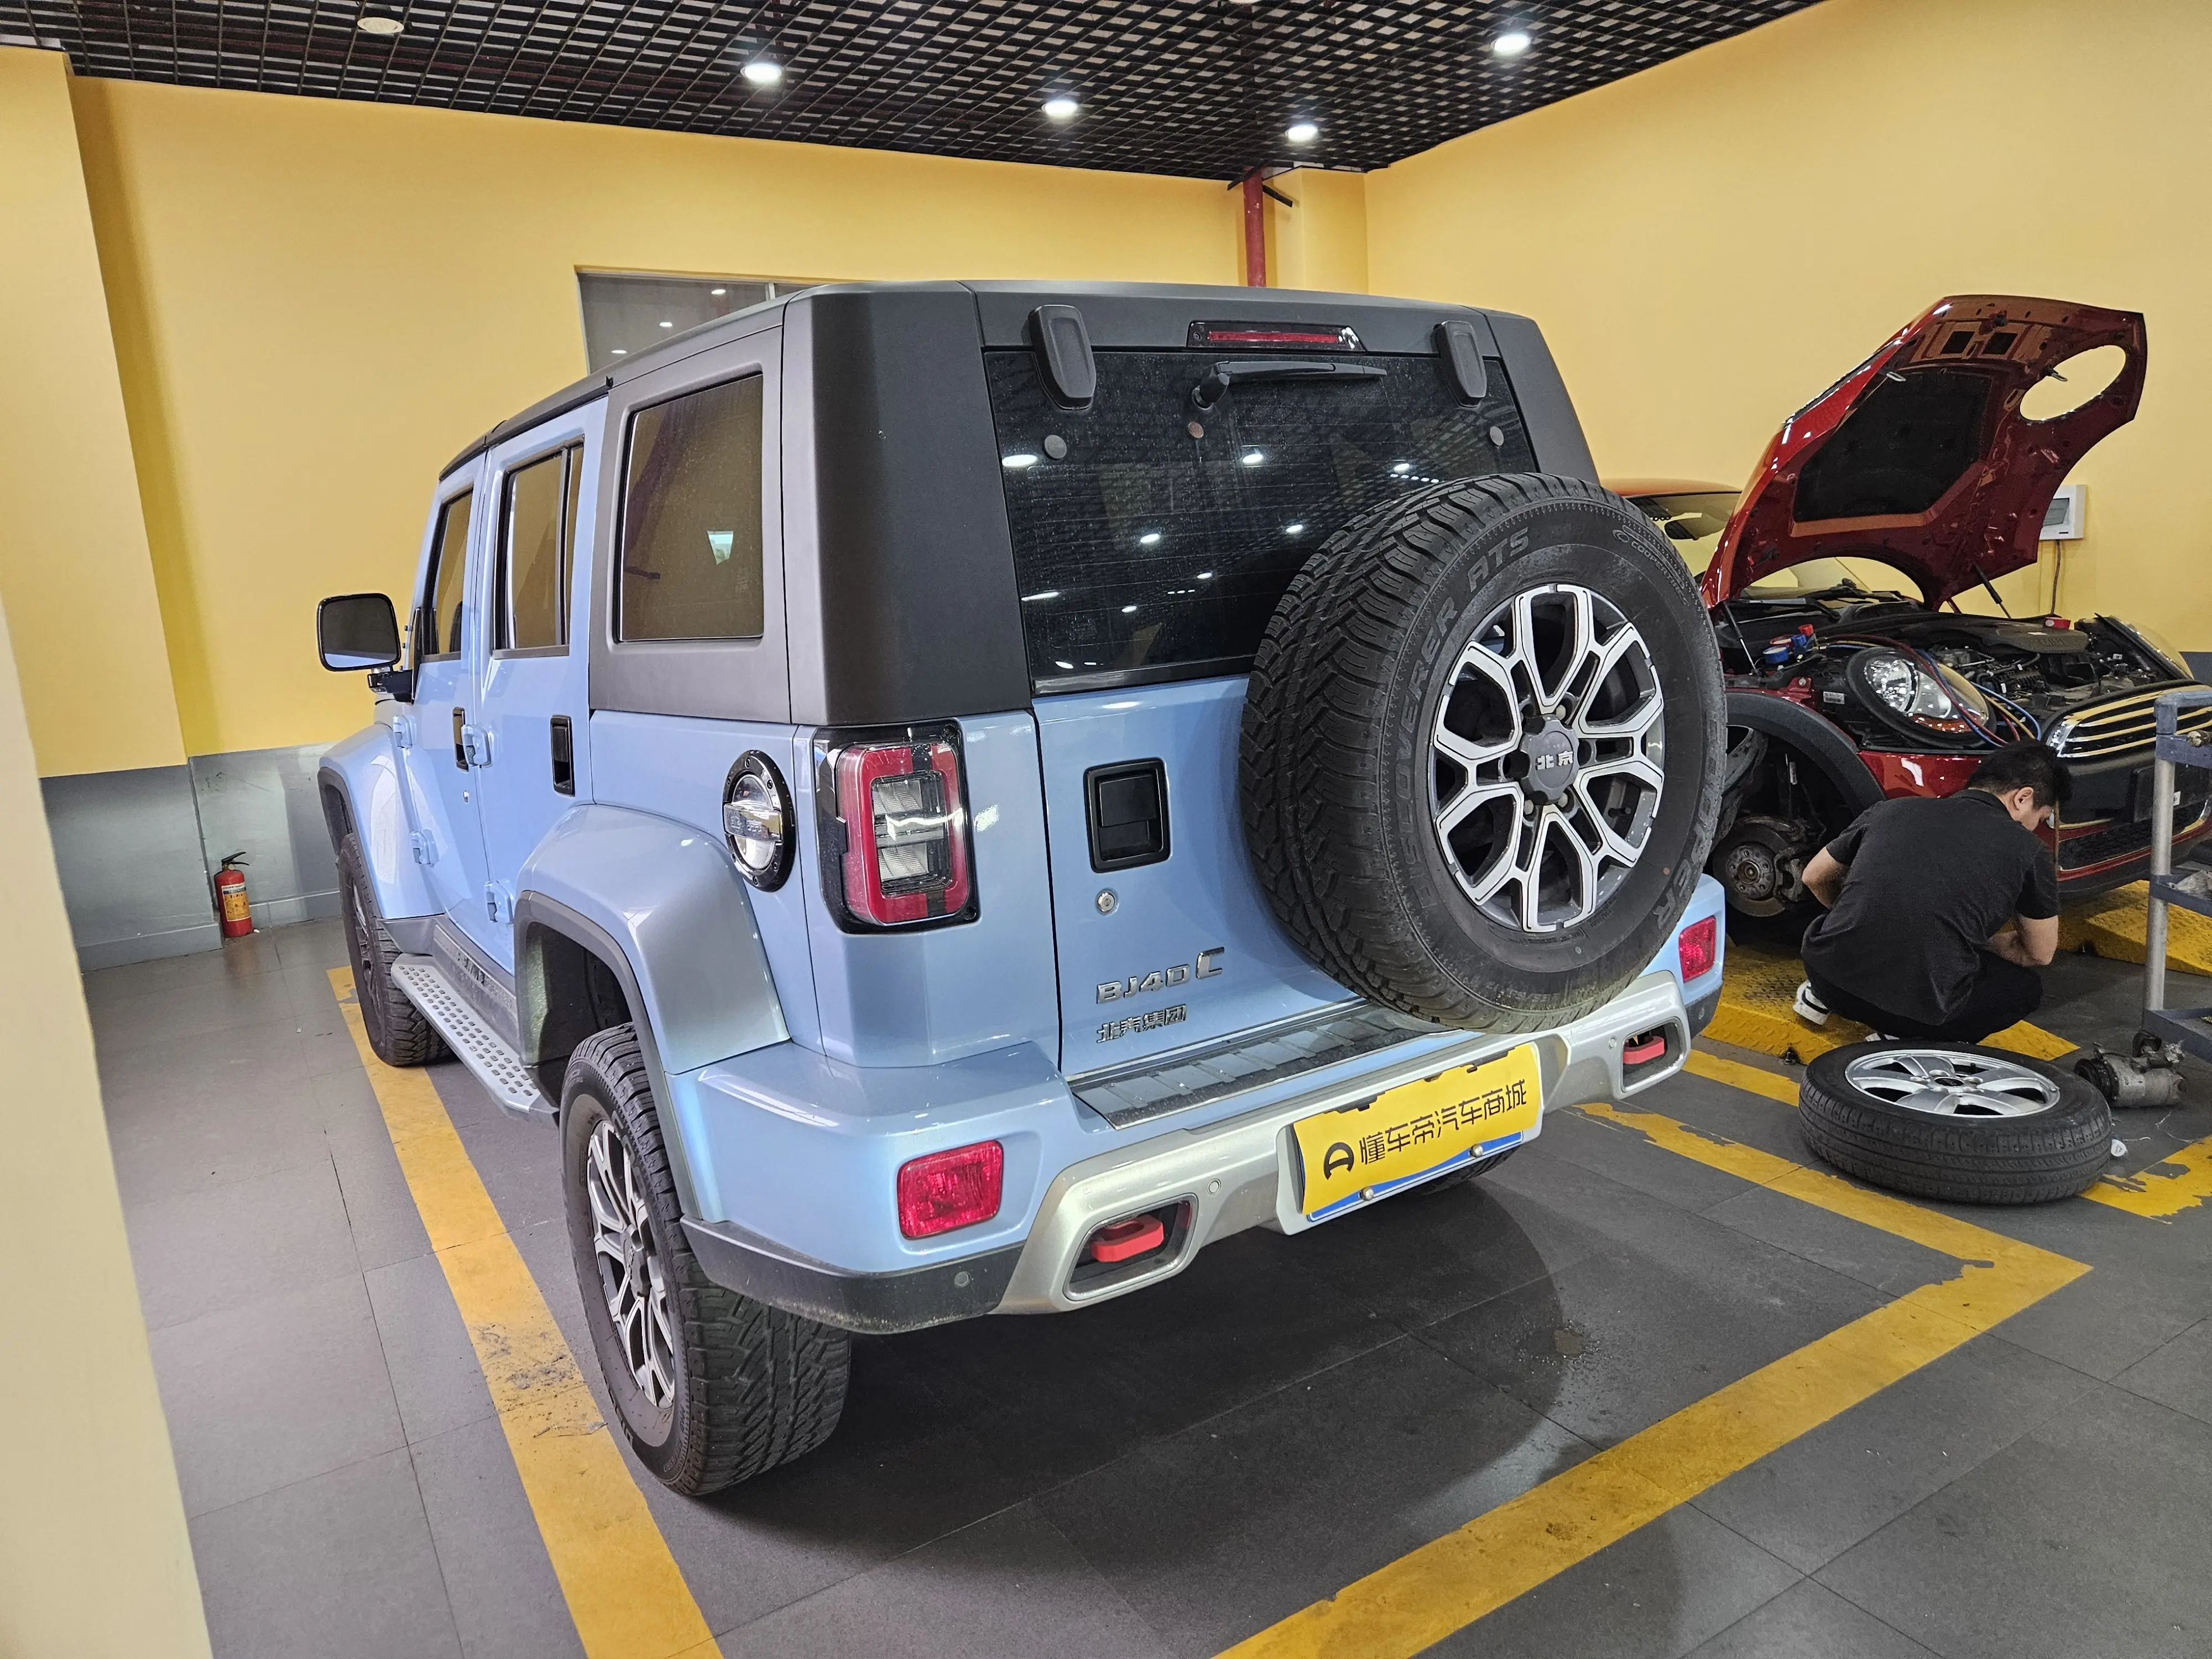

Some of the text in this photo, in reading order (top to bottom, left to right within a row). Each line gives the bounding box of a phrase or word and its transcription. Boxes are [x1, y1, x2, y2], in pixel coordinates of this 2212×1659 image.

[1468, 526, 1529, 593] ATS
[1535, 750, 1574, 770] 北京
[1097, 946, 1225, 1004] BJ40 C
[1097, 1004, 1187, 1044] 北汽集团
[1359, 1078, 1527, 1165] 懂车帝汽车商城
